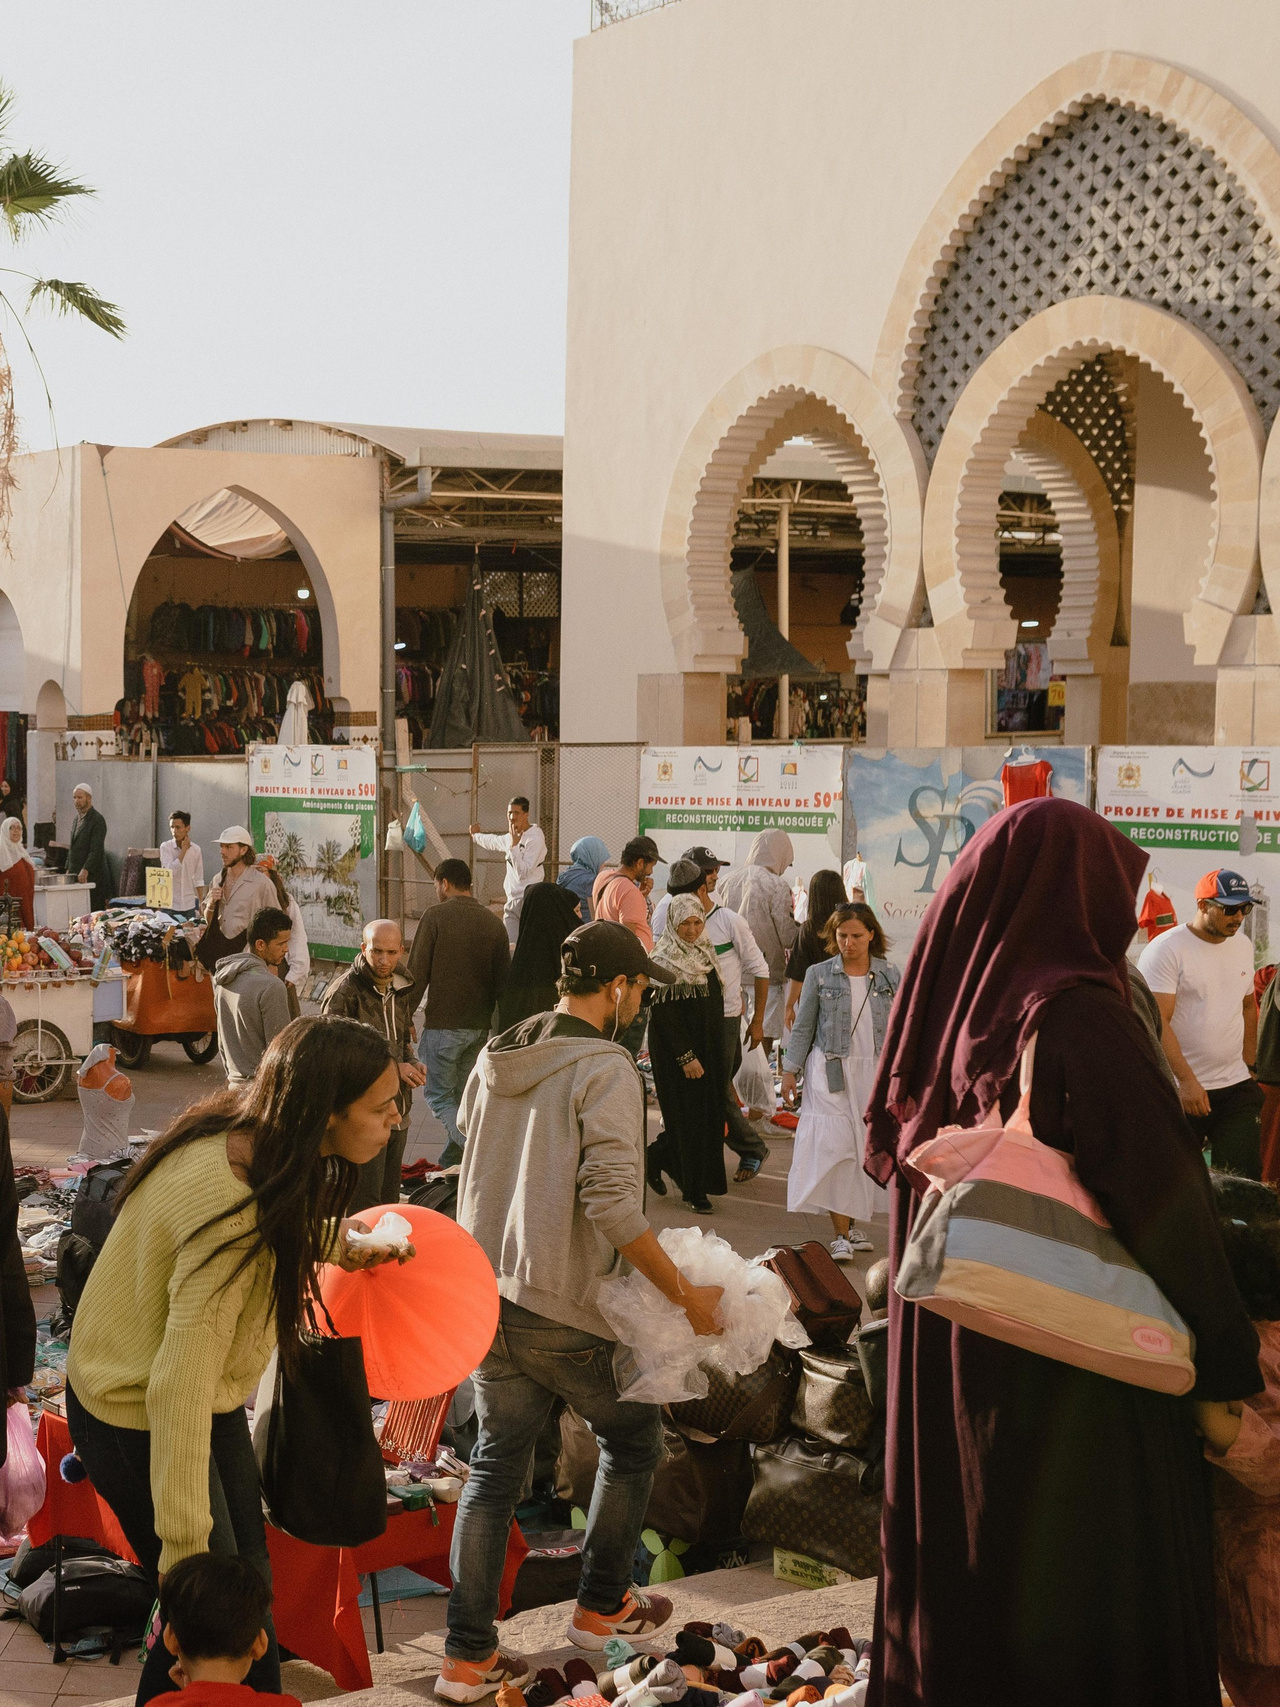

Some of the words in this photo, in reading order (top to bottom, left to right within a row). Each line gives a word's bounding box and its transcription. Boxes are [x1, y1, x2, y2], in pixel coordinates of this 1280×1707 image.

[255, 786, 280, 794] PROJET
[293, 787, 308, 795] MISE
[310, 787, 315, 795] A
[318, 788, 344, 796] NIVEAU
[347, 788, 356, 796] DE
[648, 796, 686, 805] PROJET
[689, 797, 703, 806] DE
[706, 797, 732, 806] MISE
[735, 797, 743, 806] A
[748, 797, 791, 808] NIVEAU
[795, 798, 809, 808] DE
[1104, 805, 1160, 817] PROJET
[1166, 807, 1184, 818] DE
[1191, 808, 1229, 820] MISE
[666, 813, 744, 824] RECONSTRUCTION
[748, 815, 760, 825] DE
[763, 816, 775, 826] LA
[777, 815, 823, 827] MOSQUÉE
[1130, 827, 1239, 843] RECONSTRUCTIO
[150, 884, 170, 901] 10
